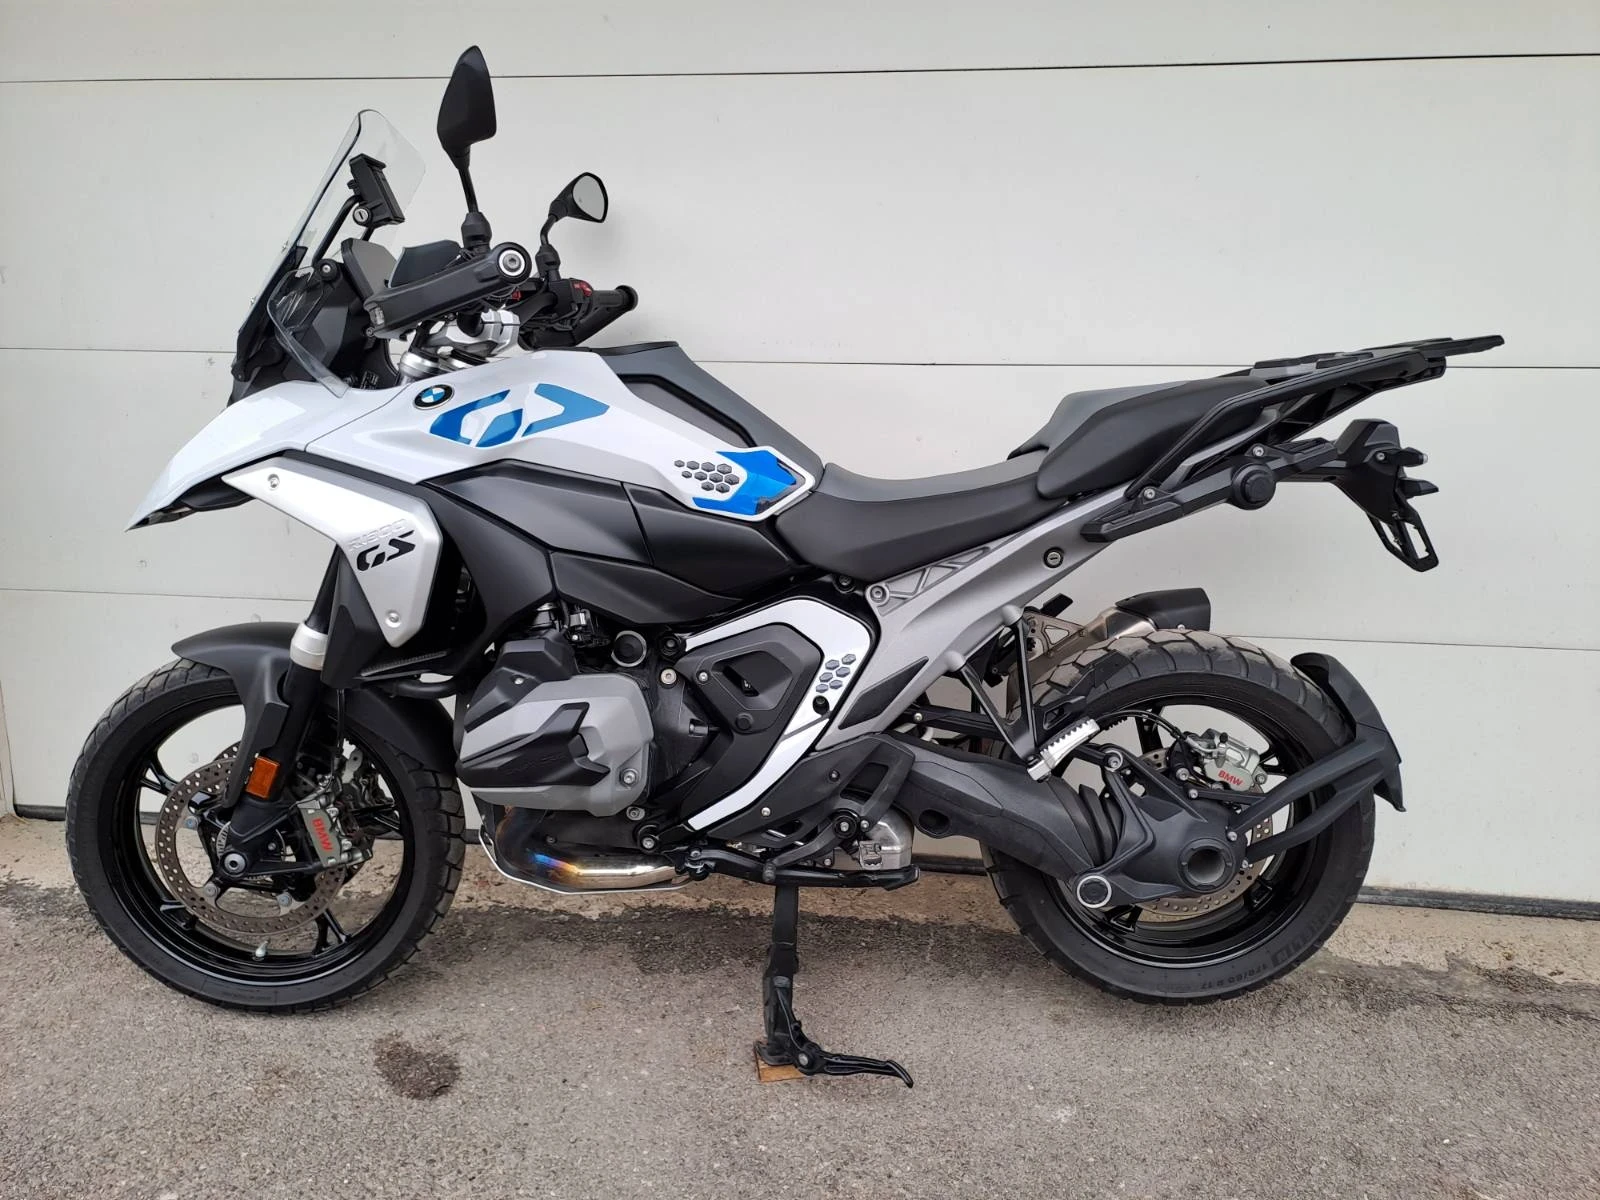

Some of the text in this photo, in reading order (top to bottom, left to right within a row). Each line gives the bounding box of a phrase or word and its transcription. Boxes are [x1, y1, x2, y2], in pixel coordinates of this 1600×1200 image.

[356, 529, 416, 572] GS
[1218, 770, 1244, 786] BMW
[312, 818, 333, 850] BMW
